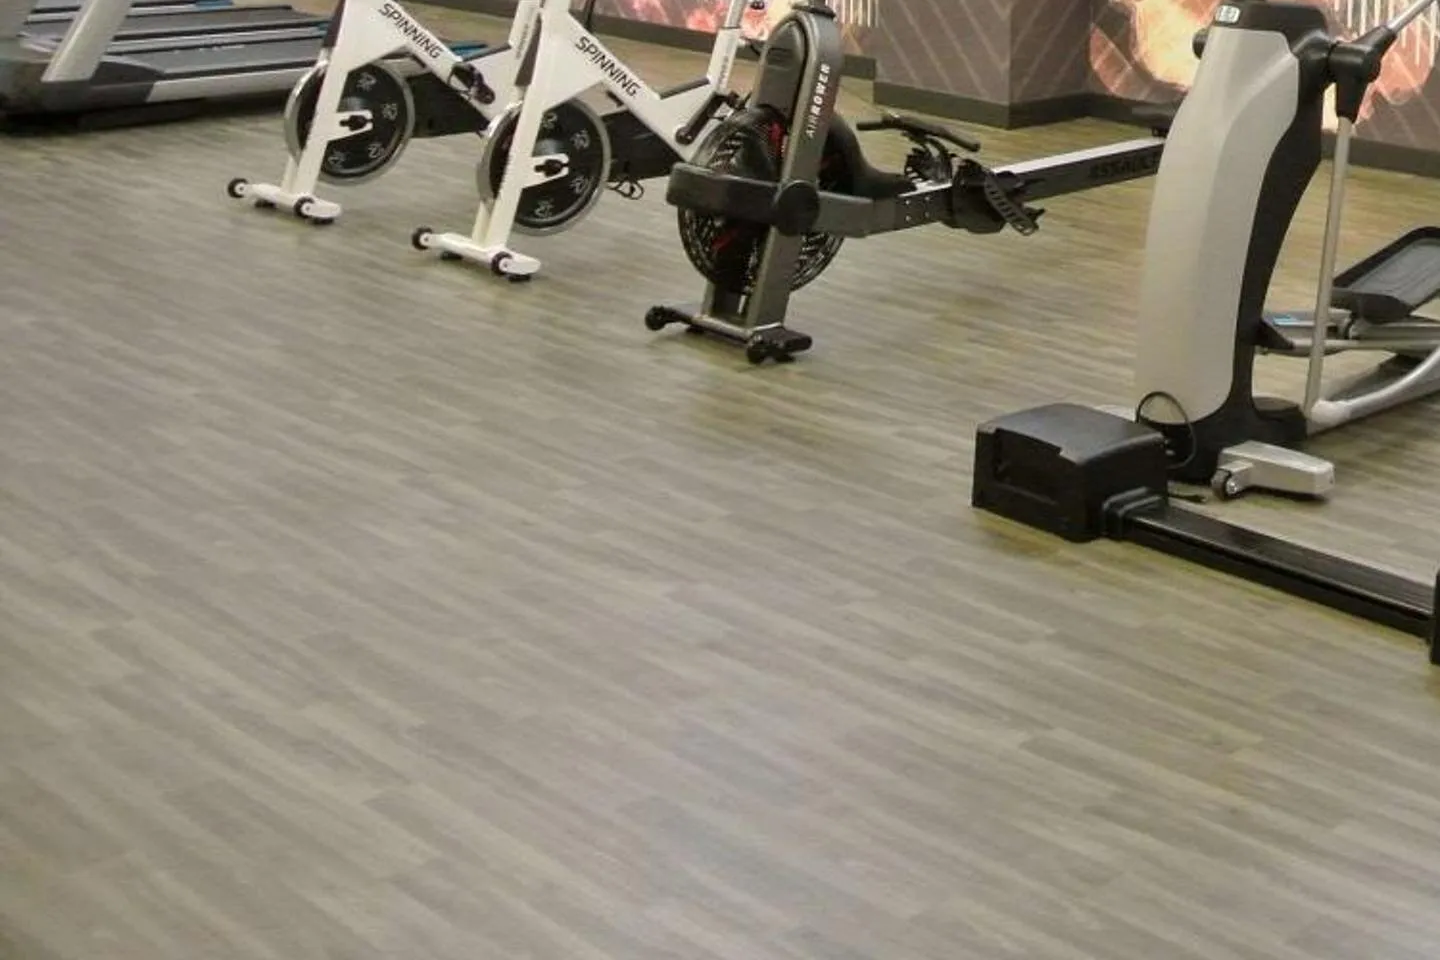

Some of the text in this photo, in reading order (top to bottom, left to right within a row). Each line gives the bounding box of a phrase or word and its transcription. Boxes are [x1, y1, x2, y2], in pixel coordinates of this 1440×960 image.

[378, 3, 444, 59] SPINNING
[575, 36, 641, 97] SPINNING
[805, 63, 831, 139] AIRROWER
